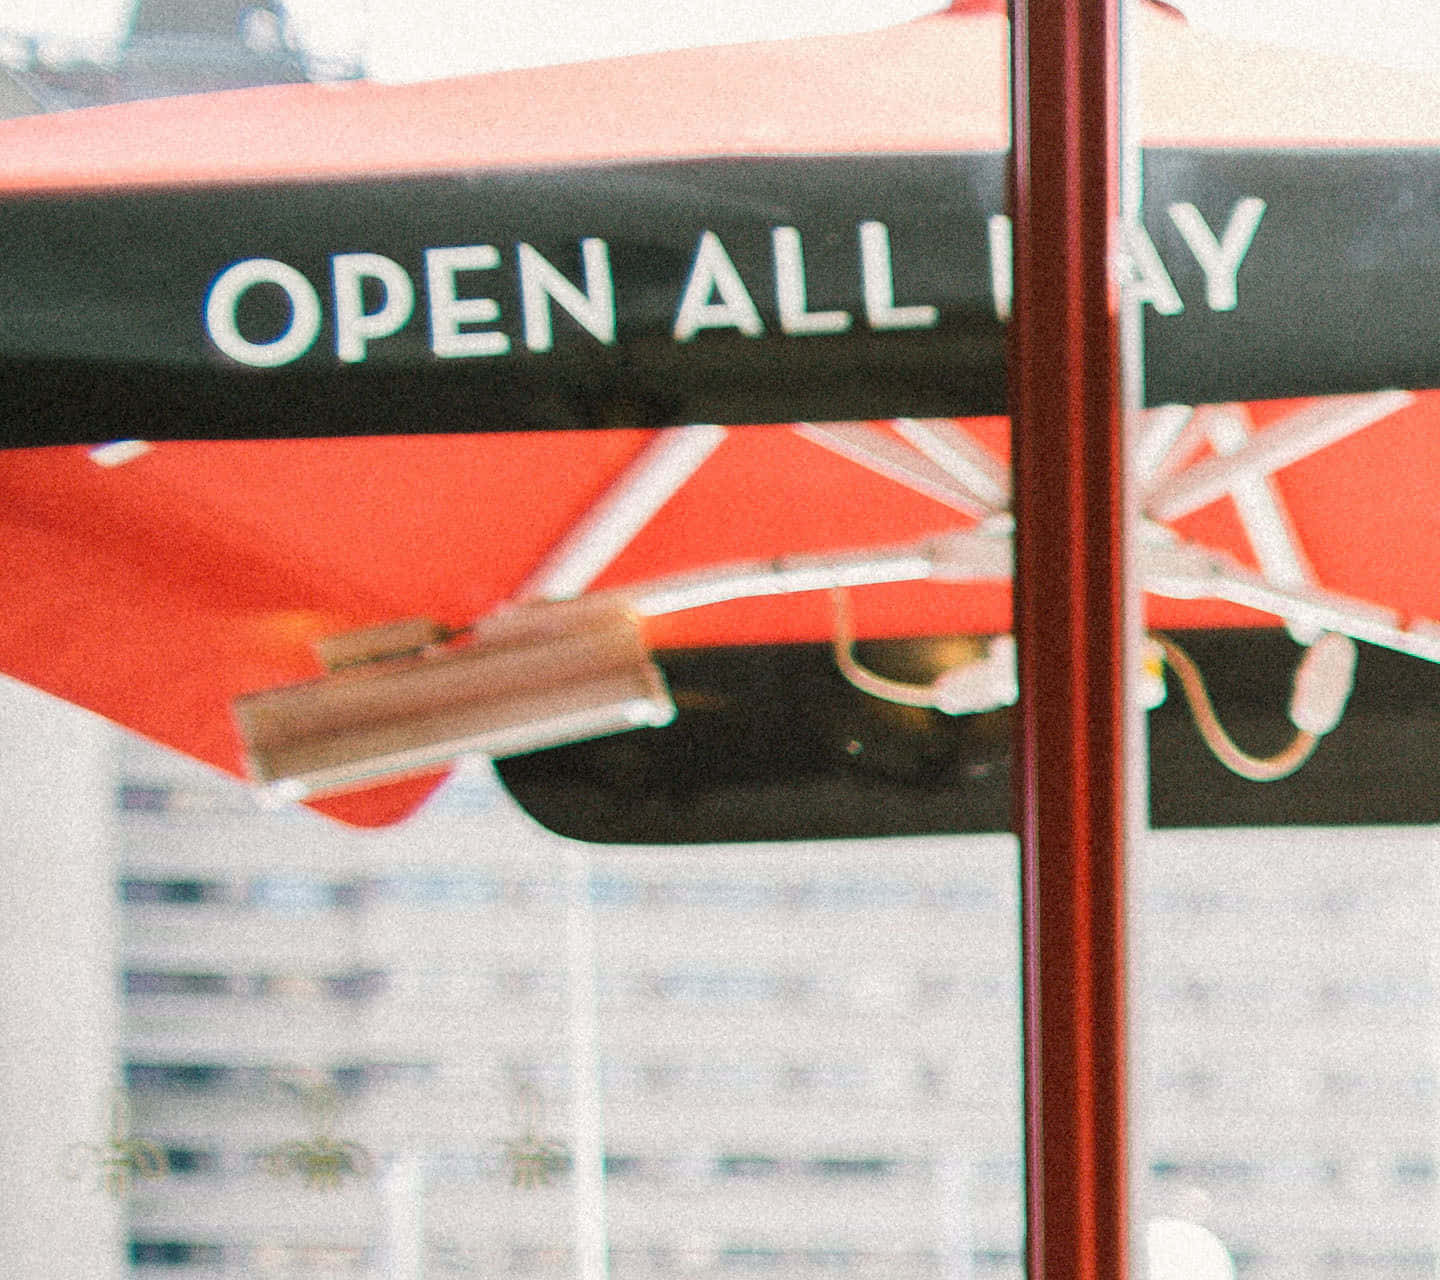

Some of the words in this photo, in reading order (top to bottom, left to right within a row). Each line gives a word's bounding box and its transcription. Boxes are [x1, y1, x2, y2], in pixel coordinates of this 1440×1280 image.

[204, 236, 617, 368] OPEN
[673, 219, 940, 342] ALL
[986, 197, 1268, 322] AY
